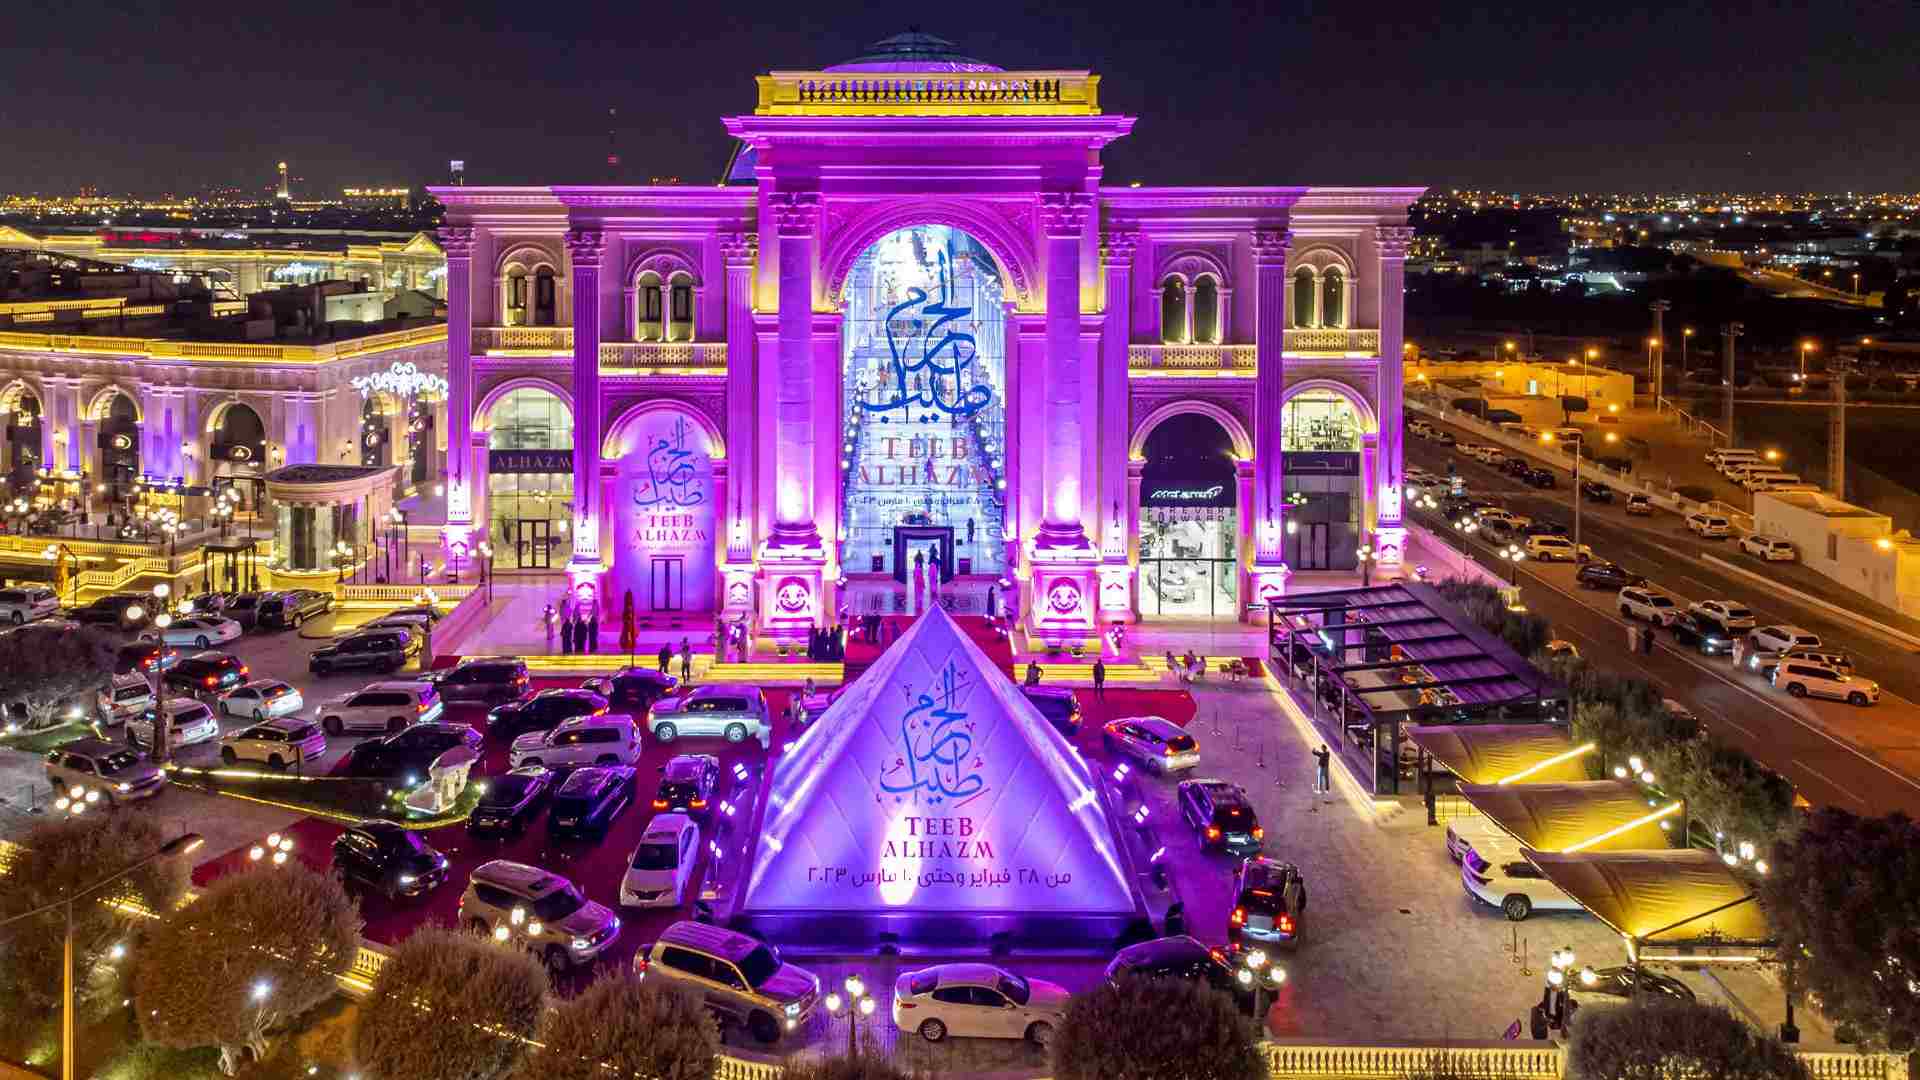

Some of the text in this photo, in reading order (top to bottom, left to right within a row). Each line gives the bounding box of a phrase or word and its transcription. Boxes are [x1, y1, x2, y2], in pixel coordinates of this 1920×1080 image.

[880, 437, 969, 459] TEEB
[496, 455, 571, 469] ALHAZM
[648, 514, 694, 528] TEEB
[633, 530, 706, 541] ALHAZM
[904, 816, 974, 836] TEEB
[883, 840, 994, 858] ALHAZM
[917, 867, 966, 888] وحتى
[970, 867, 1011, 887] فبراير
[1046, 872, 1072, 888] من
